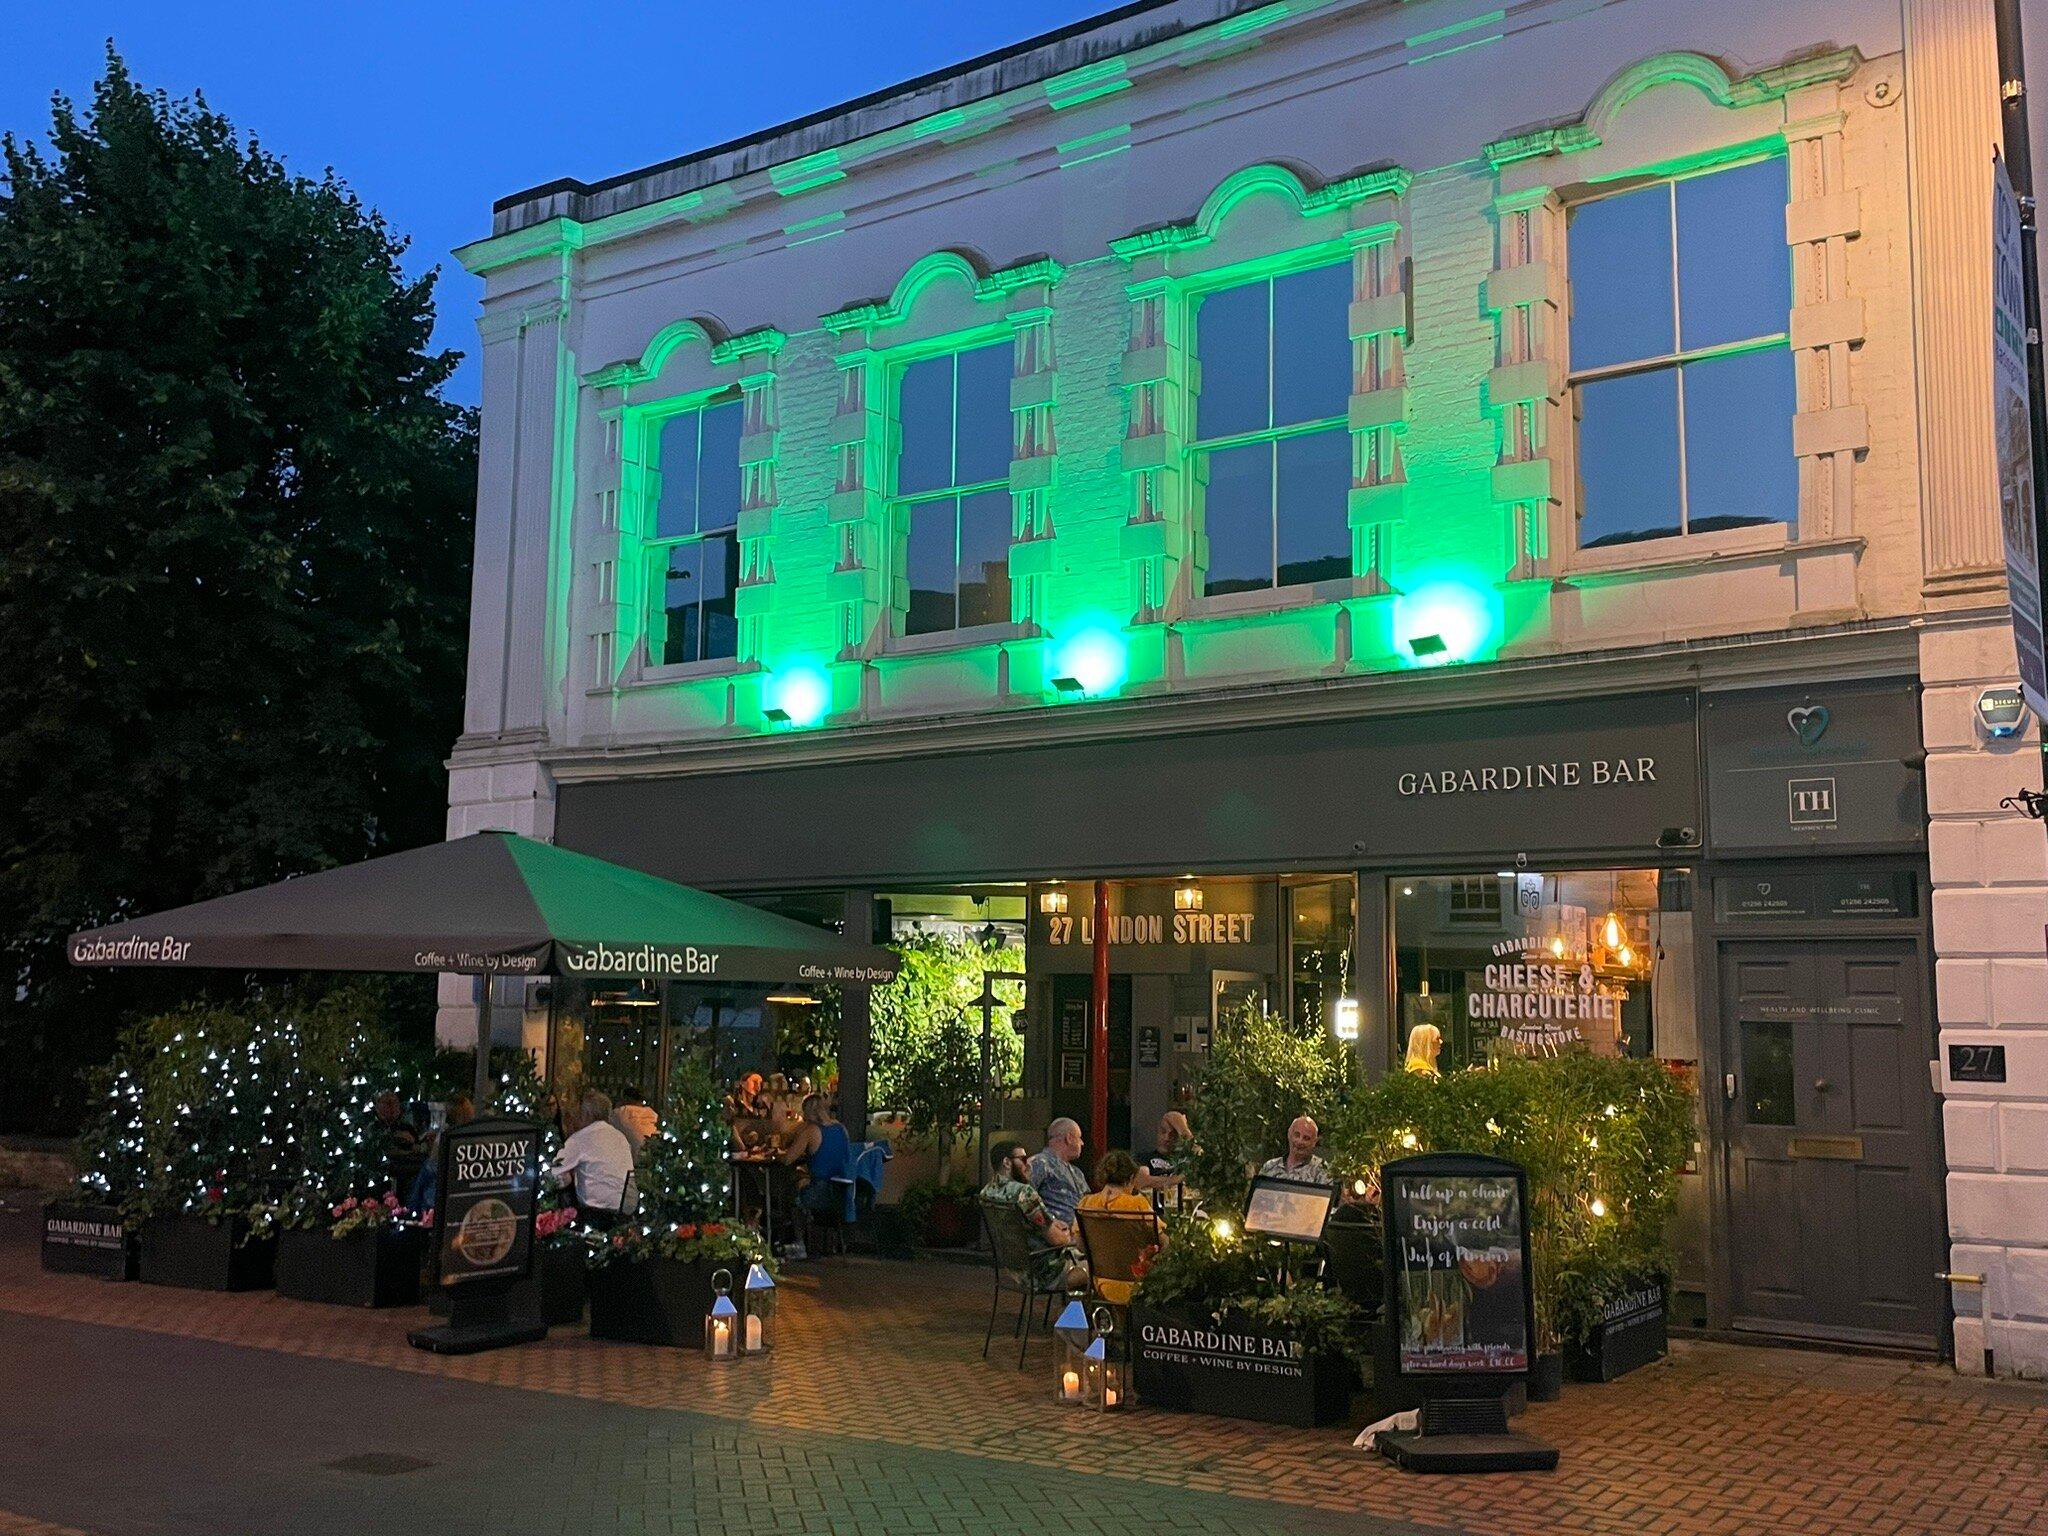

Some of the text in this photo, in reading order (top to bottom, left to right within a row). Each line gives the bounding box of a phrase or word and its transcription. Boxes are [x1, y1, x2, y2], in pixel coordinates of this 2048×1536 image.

[1398, 757, 1657, 796] GABARDINE BAR
[1793, 789, 1832, 811] TH
[1050, 913, 1255, 945] 27 LNDON STREET
[74, 935, 191, 962] Gabardine Bar
[567, 942, 719, 974] Gabardine Bar
[414, 952, 446, 967] Coffee
[457, 953, 484, 967] Wine
[485, 953, 500, 970] by
[502, 954, 537, 971] Design
[799, 965, 826, 979] Coffee
[833, 966, 855, 979] Wine
[855, 966, 866, 982] by
[867, 967, 894, 982] Design
[1485, 964, 1594, 991] CHEESE &
[1469, 992, 1614, 1020] CHARCUTERIE
[1809, 1006, 1851, 1014] WELLBEING
[1500, 1025, 1582, 1046] BASINGSTOKE
[1961, 1046, 1994, 1073] 27
[456, 1140, 529, 1163] SUNDAY
[457, 1158, 526, 1181] ROASTS
[1435, 1187, 1454, 1204] up
[1459, 1189, 1468, 1199] a
[1472, 1183, 1509, 1199] chair
[47, 1219, 122, 1238] GABARDINE BAR
[1413, 1214, 1502, 1237] Enjoy a cold
[1408, 1246, 1434, 1268] Jug
[1438, 1251, 1453, 1268] of
[1142, 1325, 1302, 1359] GABARDINE BAR
[1143, 1349, 1189, 1364] COFFEE
[1200, 1356, 1234, 1369] WINE
[1236, 1361, 1251, 1371] BY
[1254, 1363, 1302, 1377] DESIGN
